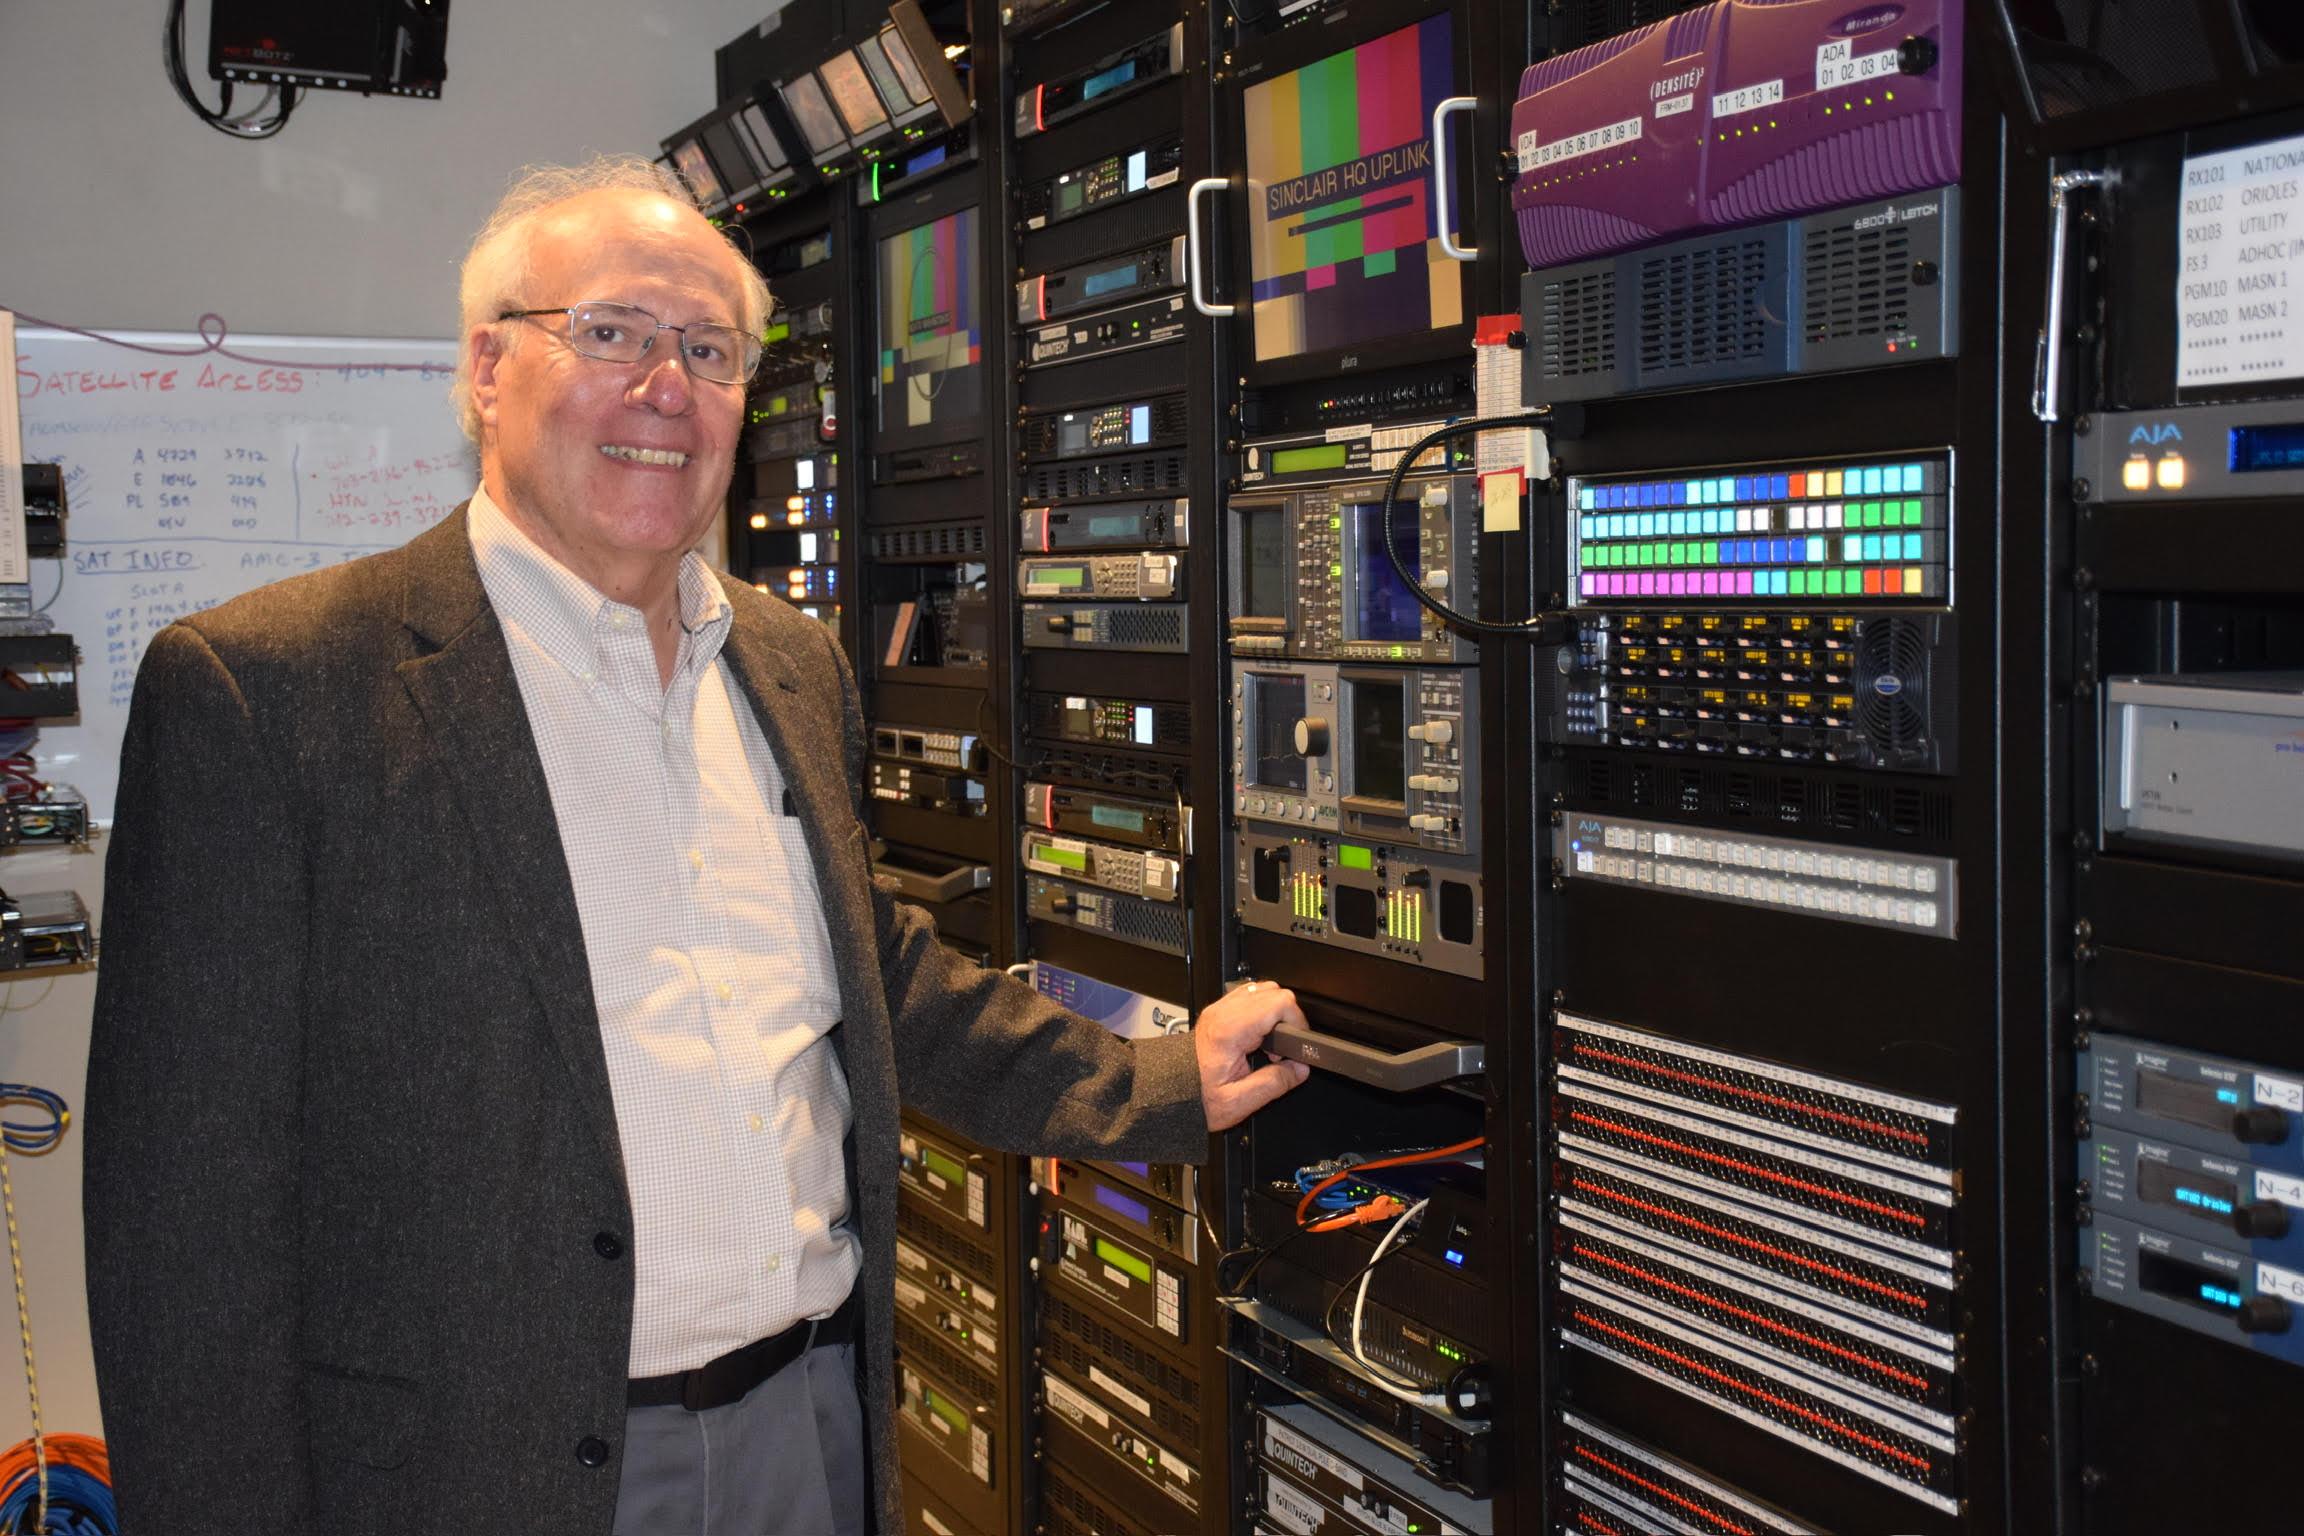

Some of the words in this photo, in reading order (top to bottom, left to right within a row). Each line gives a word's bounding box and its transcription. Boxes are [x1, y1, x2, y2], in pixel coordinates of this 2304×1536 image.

[1846, 12, 1897, 31] Miranda
[1822, 44, 1846, 63] ADA
[1822, 68, 1834, 86] 01
[1841, 63, 1854, 81] 02
[1861, 58, 1875, 76] 03
[1881, 53, 1896, 71] 04
[1719, 97, 1729, 113] 11
[1735, 91, 1746, 108] 12
[1751, 87, 1763, 104] 13
[1768, 83, 1780, 100] 14
[1531, 151, 1540, 166] 02
[1541, 147, 1551, 162] 03
[1553, 145, 1562, 159] 04
[1564, 140, 1574, 155] 05
[1576, 136, 1587, 151] 06
[1589, 132, 1599, 148] 07
[1602, 128, 1612, 144] 08
[1615, 124, 1626, 140] 09
[1630, 120, 1639, 136] 10
[1269, 169, 1338, 211] SINCLAIR
[1343, 163, 1368, 191] HQ
[1370, 140, 1432, 182] UPLINK
[2187, 165, 2226, 187] RX101
[2186, 194, 2225, 216] RX102
[2241, 180, 2299, 206] ORIOLES
[1901, 203, 1938, 221] LEITCH
[2186, 223, 2223, 245] RX103
[2240, 211, 2289, 235] UTILITY
[2186, 256, 2199, 273] FS
[2201, 253, 2208, 271] 3
[2238, 241, 2286, 264] ADHOC
[2184, 279, 2228, 301] PGM10
[2237, 273, 2277, 294] MASN
[2281, 270, 2288, 289] 1
[2186, 308, 2229, 329] PGM20
[2238, 302, 2277, 322] MASN
[2281, 300, 2288, 318] 2
[16, 354, 178, 398] SATELLITE
[2129, 422, 2183, 445] AJA
[133, 448, 145, 465] A
[133, 472, 143, 487] E
[73, 550, 112, 570] SAT
[124, 550, 193, 570] INFO
[1579, 820, 1602, 833] AJA
[2257, 1082, 2300, 1103] N-2
[2259, 1178, 2301, 1199] N-4
[1274, 1441, 1318, 1481] QUINTECH
